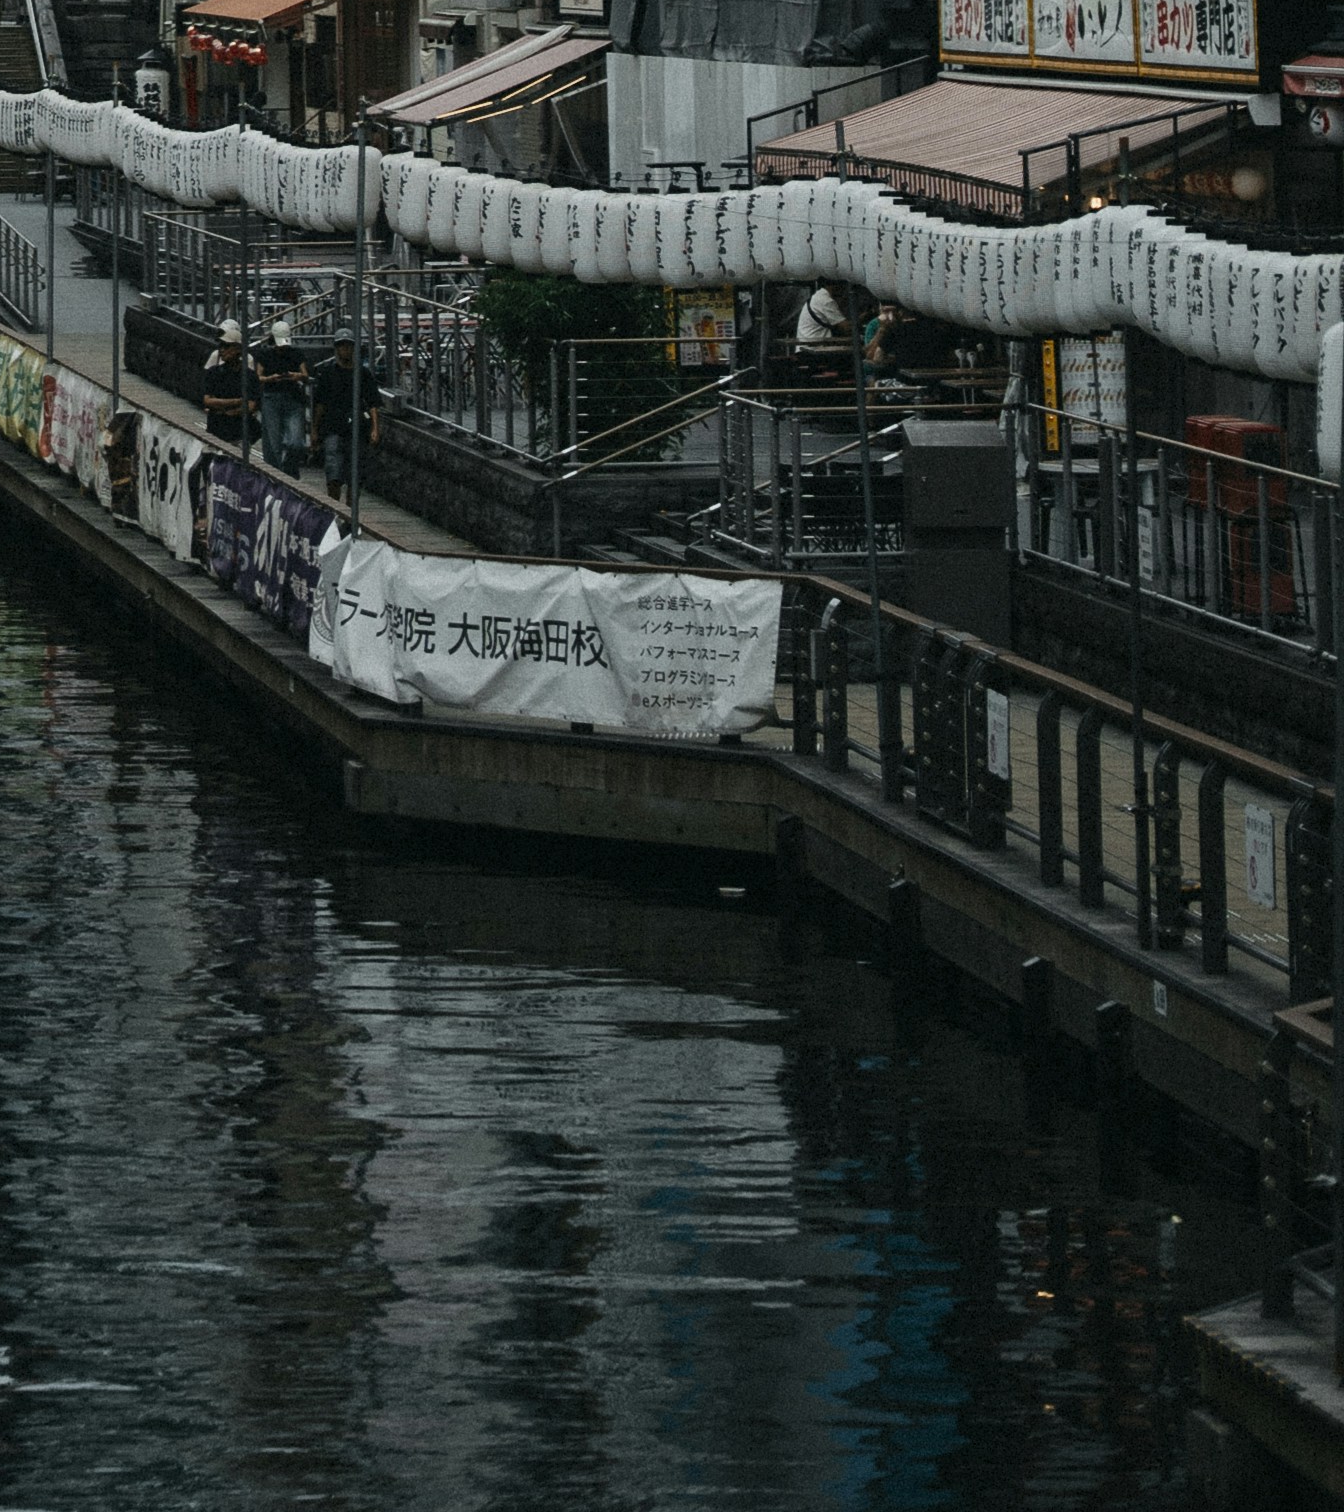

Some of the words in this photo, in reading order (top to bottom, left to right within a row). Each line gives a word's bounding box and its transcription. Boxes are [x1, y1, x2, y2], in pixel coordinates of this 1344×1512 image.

[448, 612, 608, 669] 大阪梅田校
